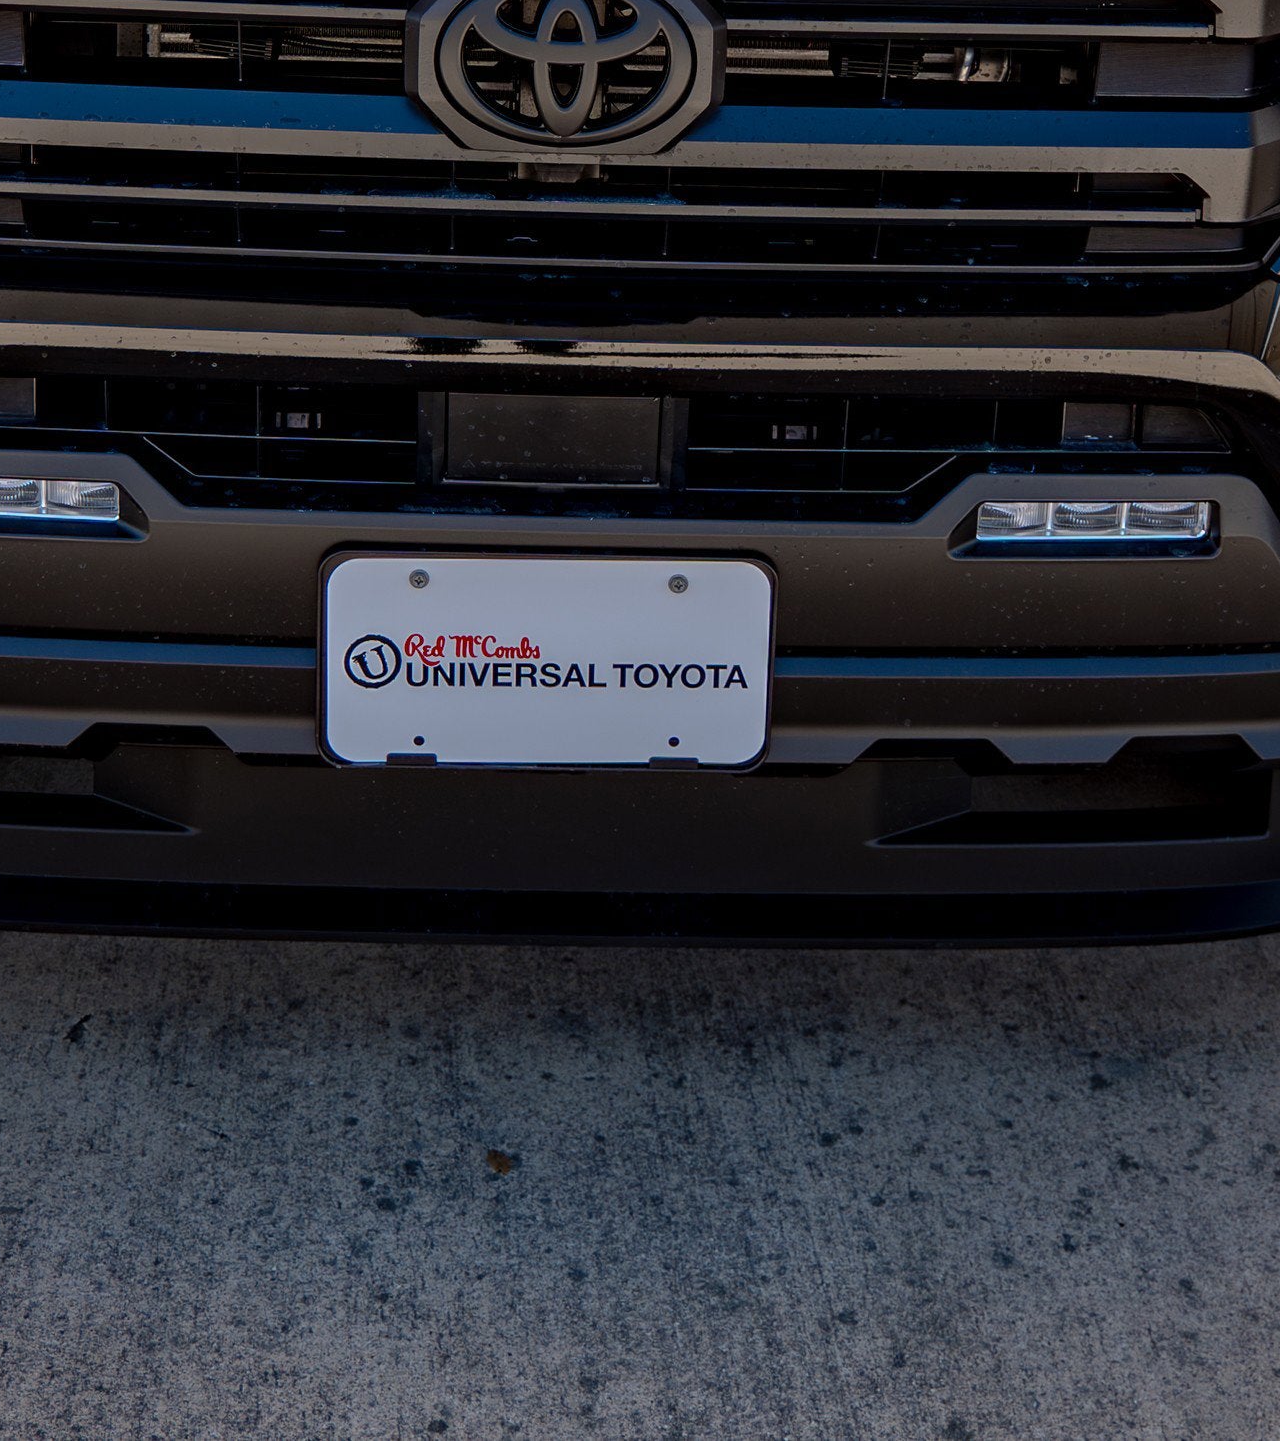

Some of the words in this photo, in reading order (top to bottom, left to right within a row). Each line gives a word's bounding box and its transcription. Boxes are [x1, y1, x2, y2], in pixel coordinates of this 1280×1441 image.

[404, 633, 446, 667] Red
[449, 635, 541, 660] McCombs
[406, 661, 607, 688] UNIVERSAL
[612, 663, 749, 689] TOYOTA
